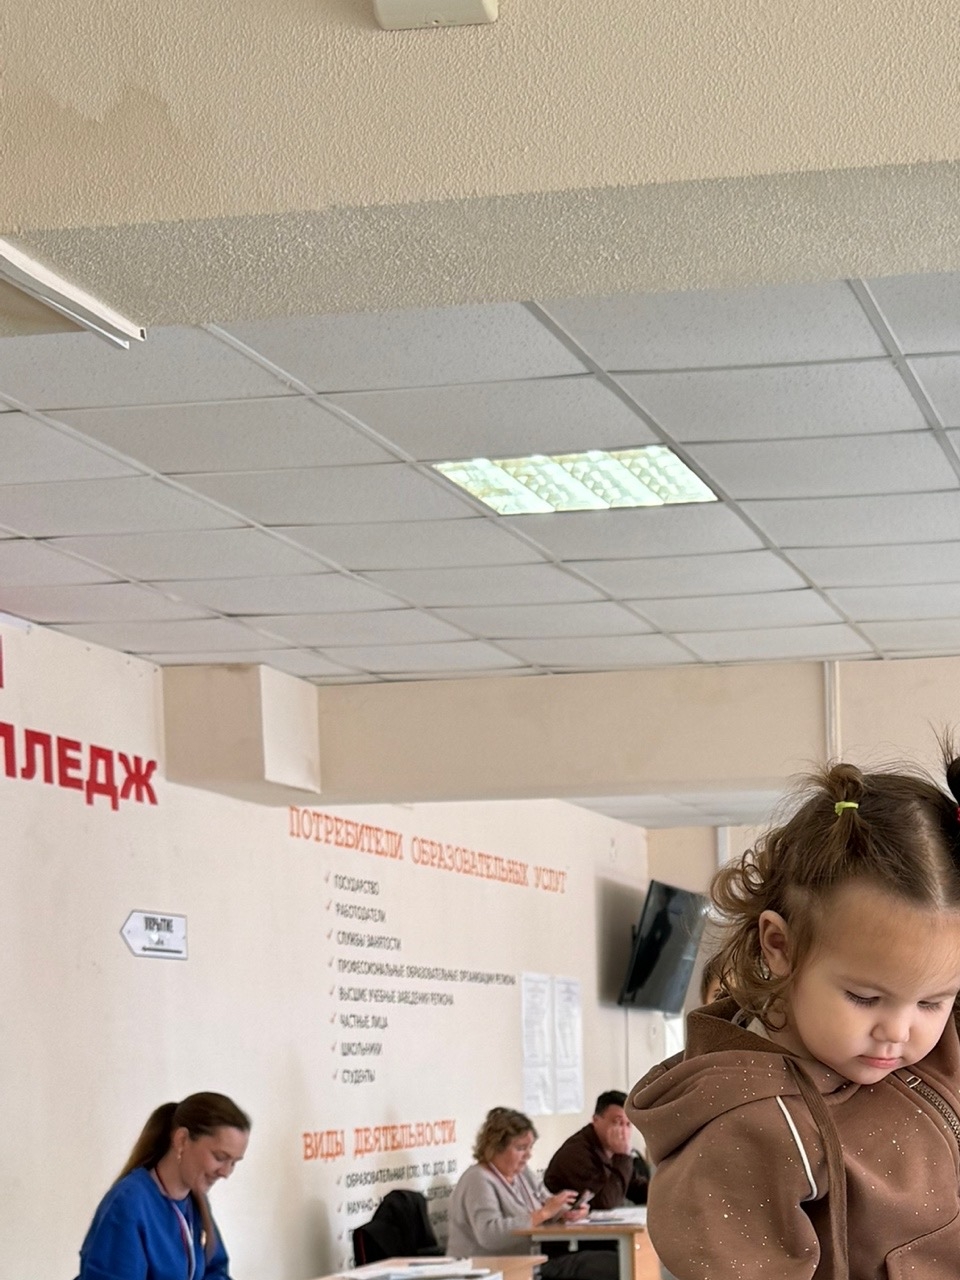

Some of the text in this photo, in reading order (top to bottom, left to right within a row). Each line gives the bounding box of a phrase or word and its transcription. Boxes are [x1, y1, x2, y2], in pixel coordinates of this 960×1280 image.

[288, 805, 567, 893] ПОТРЕБИТЕЛИ ОБРАЗОВАТЕЛЬНЫХ УСЛУГ
[334, 874, 380, 895] ГОСУДАРСТВО
[303, 1118, 456, 1163] ВИДЫ ДЕЯТЕЛЬНОСТИ
